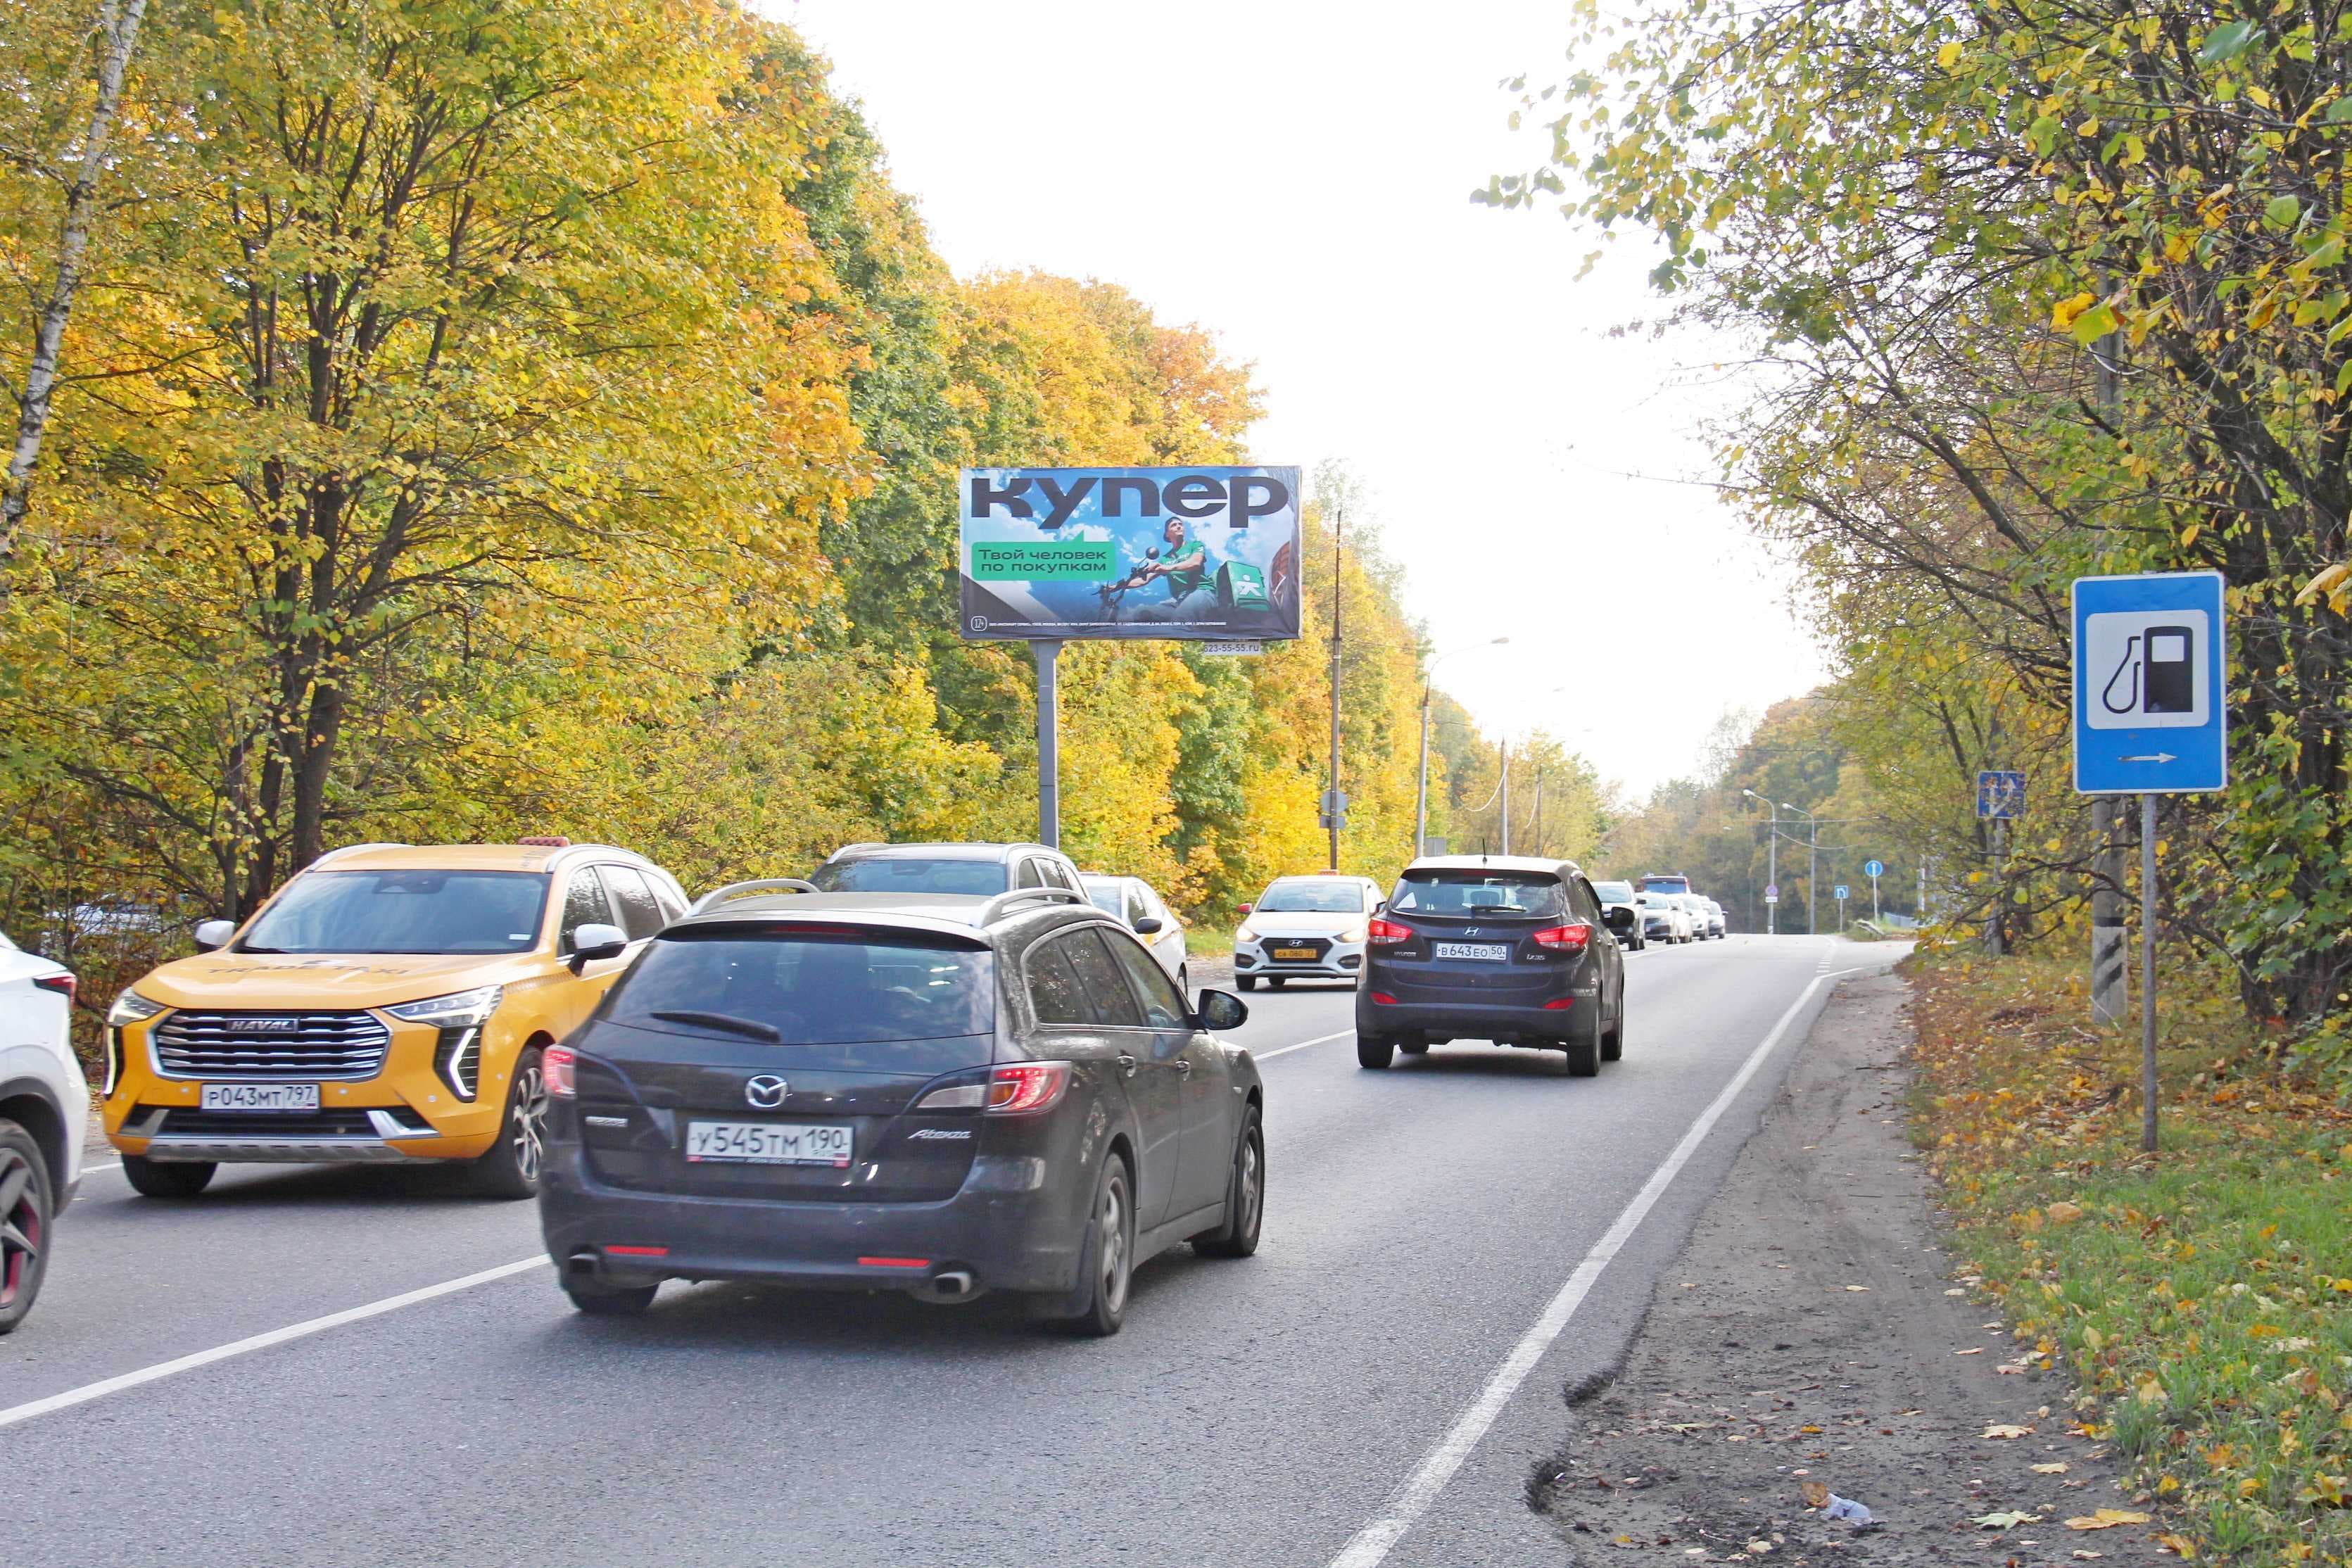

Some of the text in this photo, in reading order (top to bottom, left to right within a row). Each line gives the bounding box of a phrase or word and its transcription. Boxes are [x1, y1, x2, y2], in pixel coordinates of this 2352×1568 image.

[971, 475, 1289, 529] купер
[978, 550, 1106, 560] Твой человек
[981, 563, 1106, 574] по покупкам
[229, 1020, 293, 1030] HAVAL
